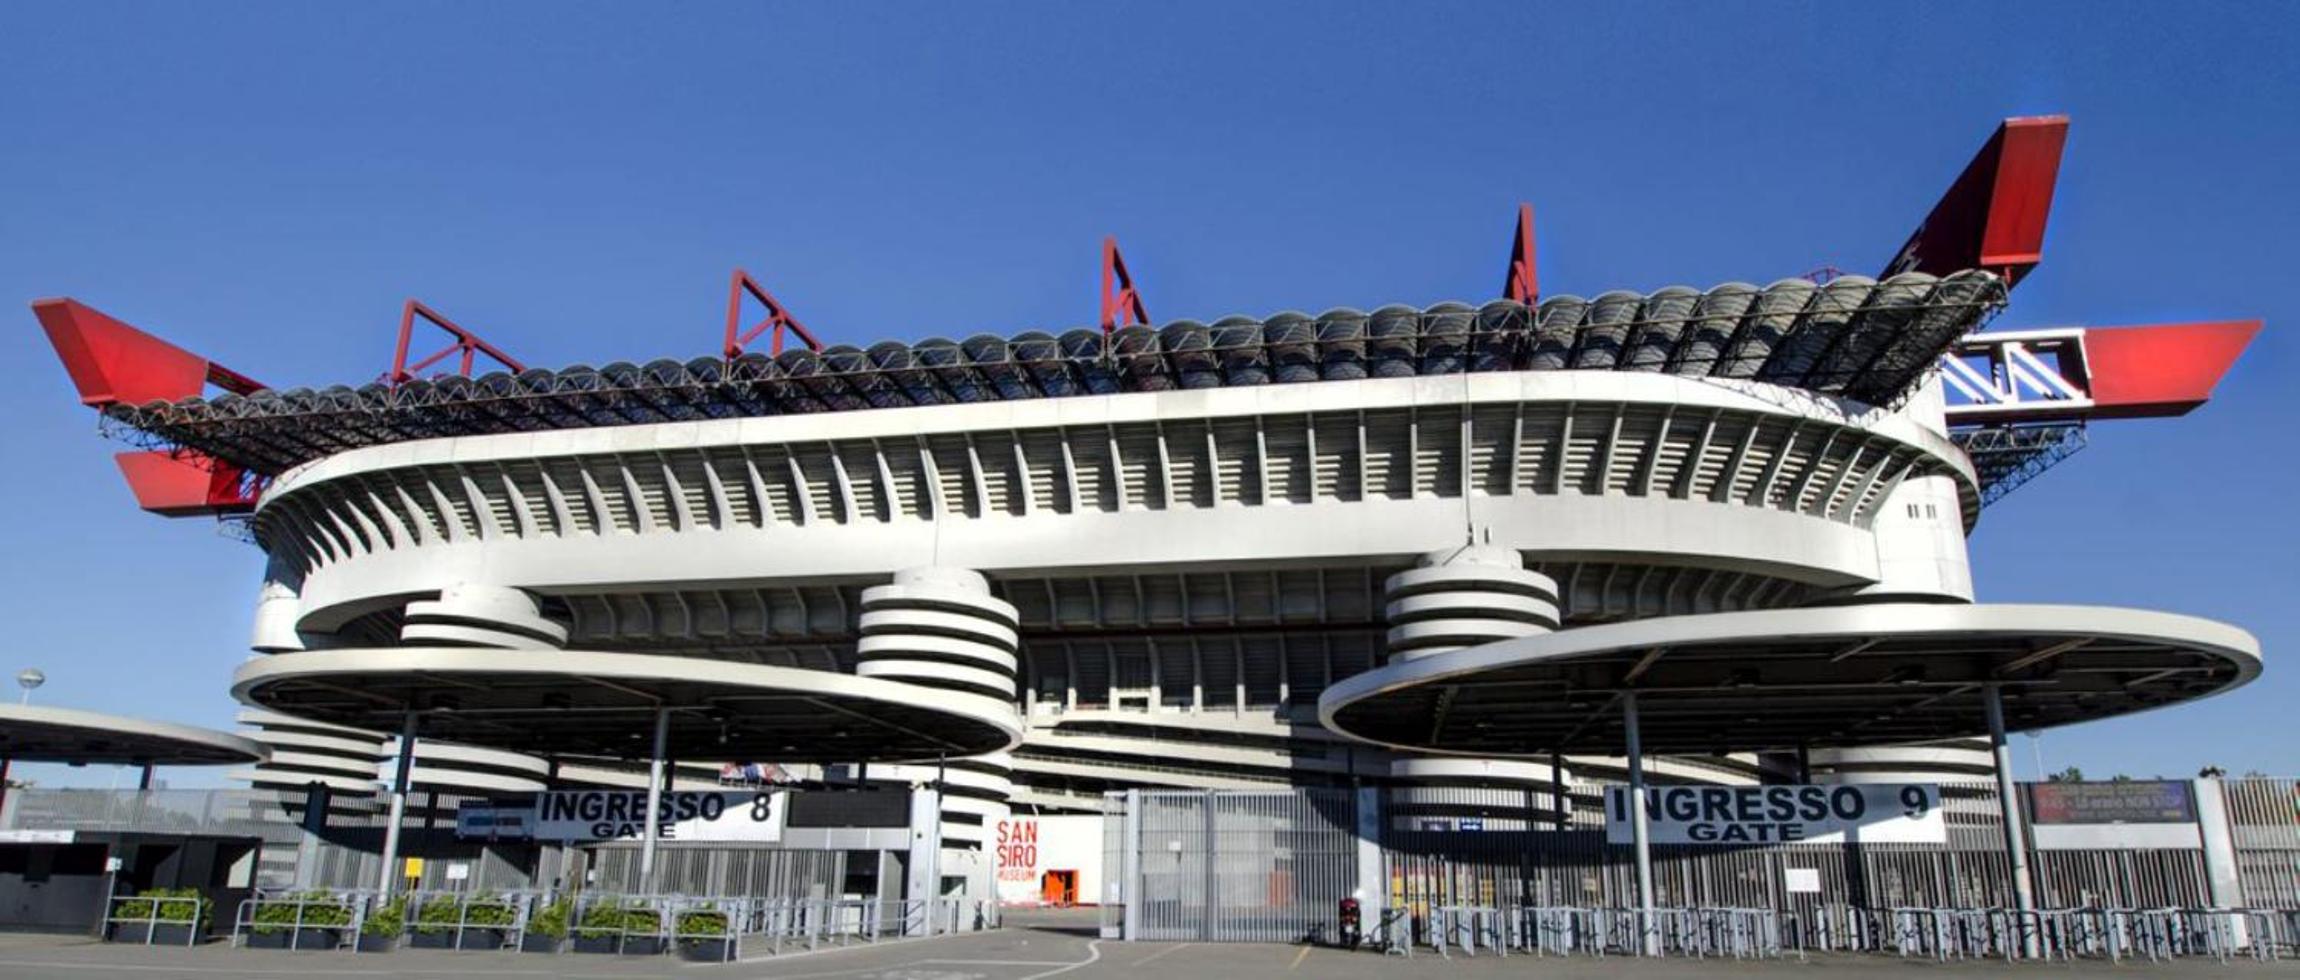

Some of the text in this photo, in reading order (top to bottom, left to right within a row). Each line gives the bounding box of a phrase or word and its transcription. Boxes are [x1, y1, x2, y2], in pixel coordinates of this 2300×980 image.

[541, 791, 771, 822] INGRESSO 8
[1613, 785, 1929, 822] INGRESSO 9
[997, 820, 1037, 843] SAN
[1687, 823, 1804, 841] GATE
[997, 845, 1037, 868] SIRO
